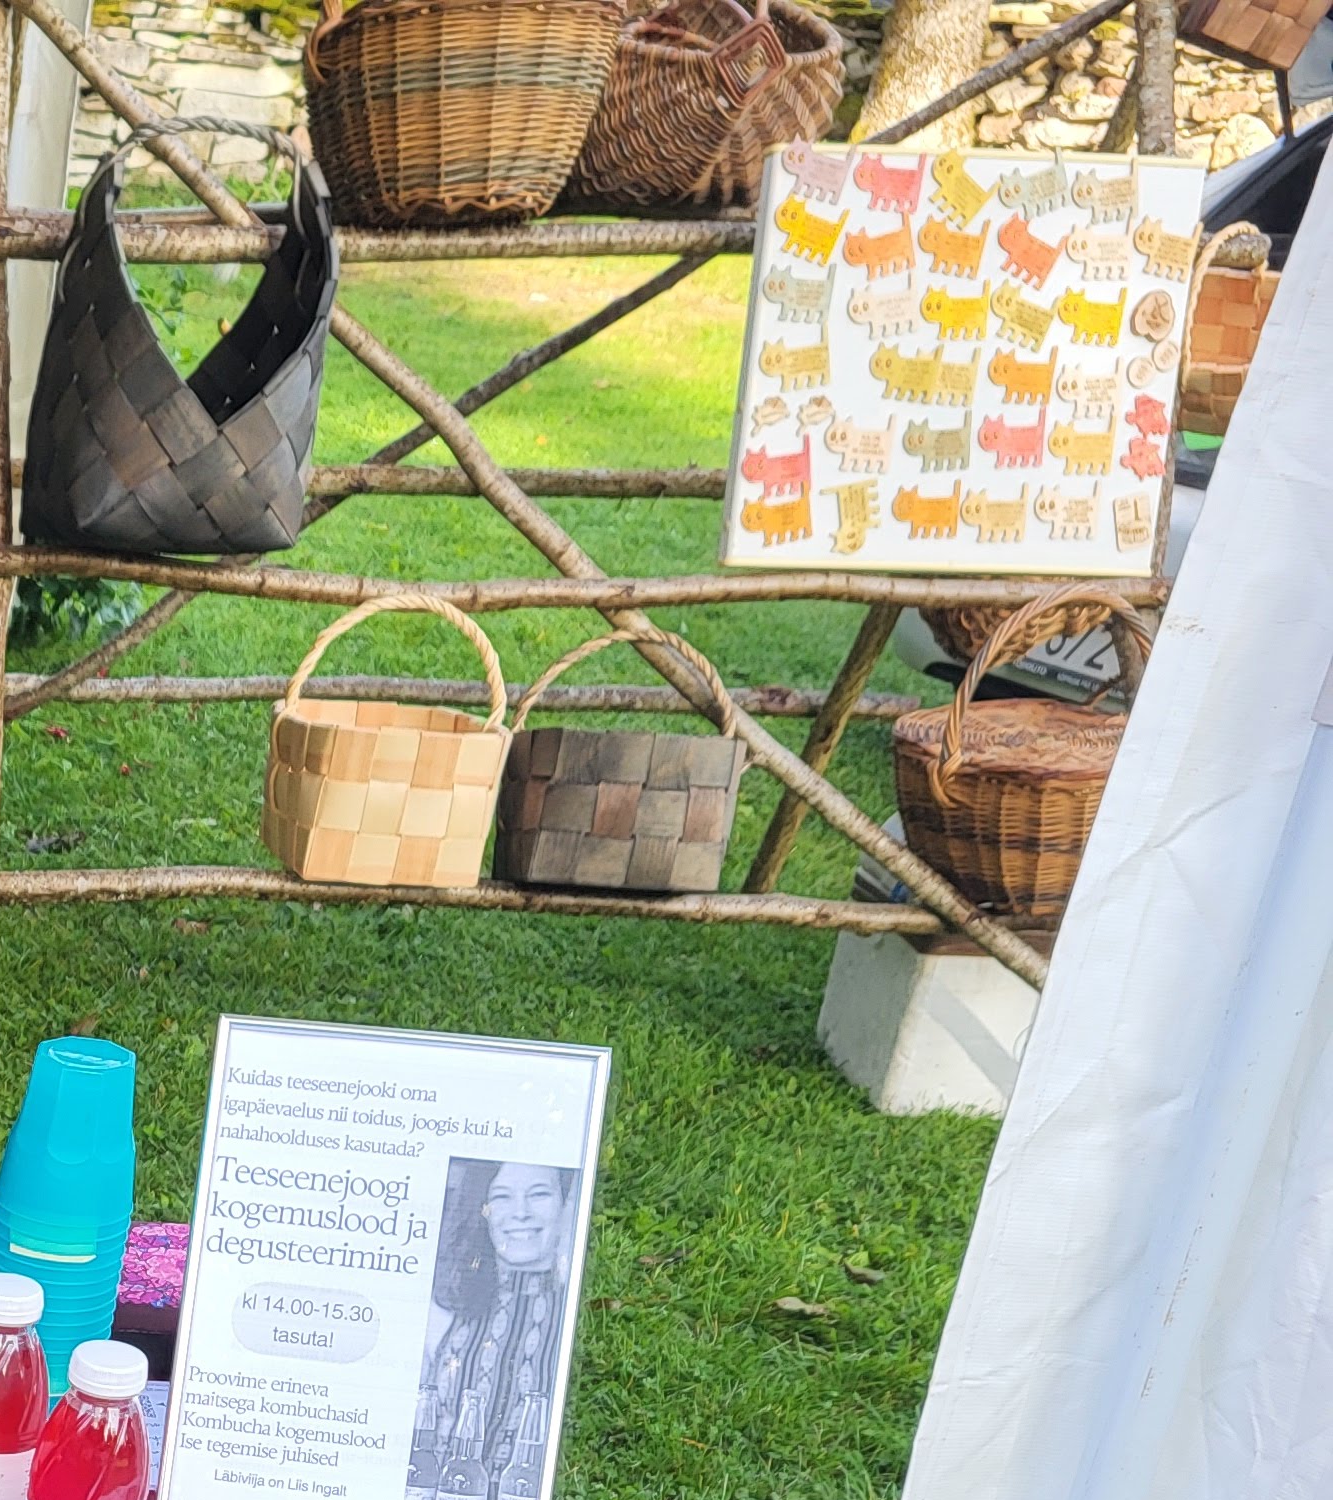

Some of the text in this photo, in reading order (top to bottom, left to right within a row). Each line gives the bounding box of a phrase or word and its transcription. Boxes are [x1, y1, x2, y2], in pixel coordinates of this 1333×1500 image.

[227, 1066, 436, 1102] Kuidas teeseenejooki oma
[223, 1094, 512, 1138] igapäevaelus nii toidus, joogis kui ka
[219, 1123, 424, 1157] nahahoolduses kasutada?
[215, 1155, 410, 1206] Teeseenejoogi
[209, 1191, 427, 1244] kogemuslood ja
[206, 1228, 418, 1274] degusteerimine
[242, 1292, 373, 1322] kl 14.00-15.30
[272, 1326, 333, 1348] tasuta!
[188, 1365, 328, 1397] Proovime erineva
[185, 1391, 368, 1424] maitsega kombuchasid
[182, 1410, 385, 1449] Kombucha kogemuslood
[179, 1432, 338, 1466] Ise tegemise juhised
[214, 1468, 346, 1497] Läbiviija on Liis Ingalt
